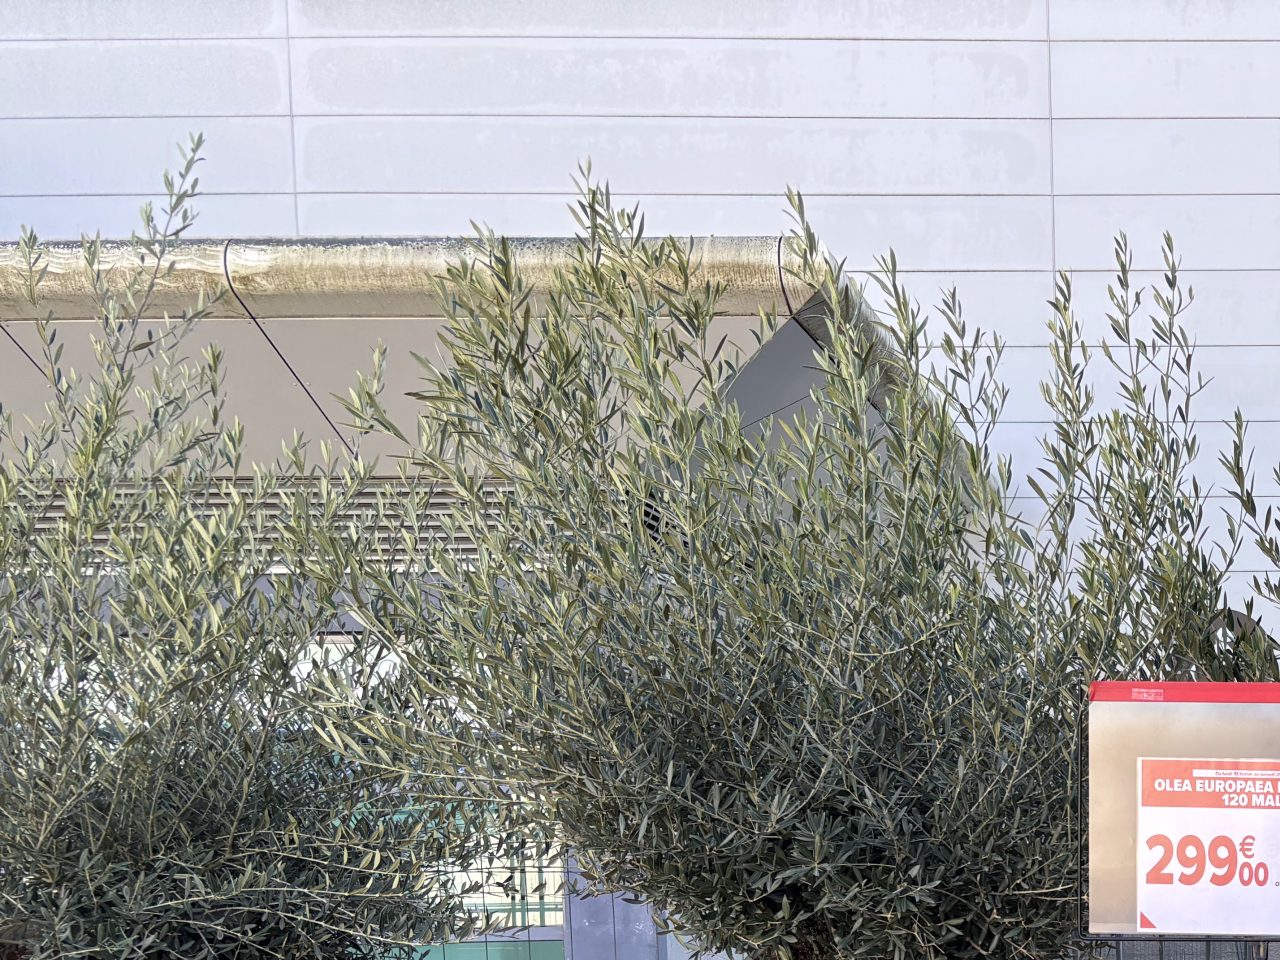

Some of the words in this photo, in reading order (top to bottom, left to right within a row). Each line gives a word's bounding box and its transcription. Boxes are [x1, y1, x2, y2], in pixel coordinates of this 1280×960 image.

[1154, 779, 1192, 792] OLEA
[1195, 780, 1274, 793] EUROPAEA
[1222, 794, 1249, 806] 120
